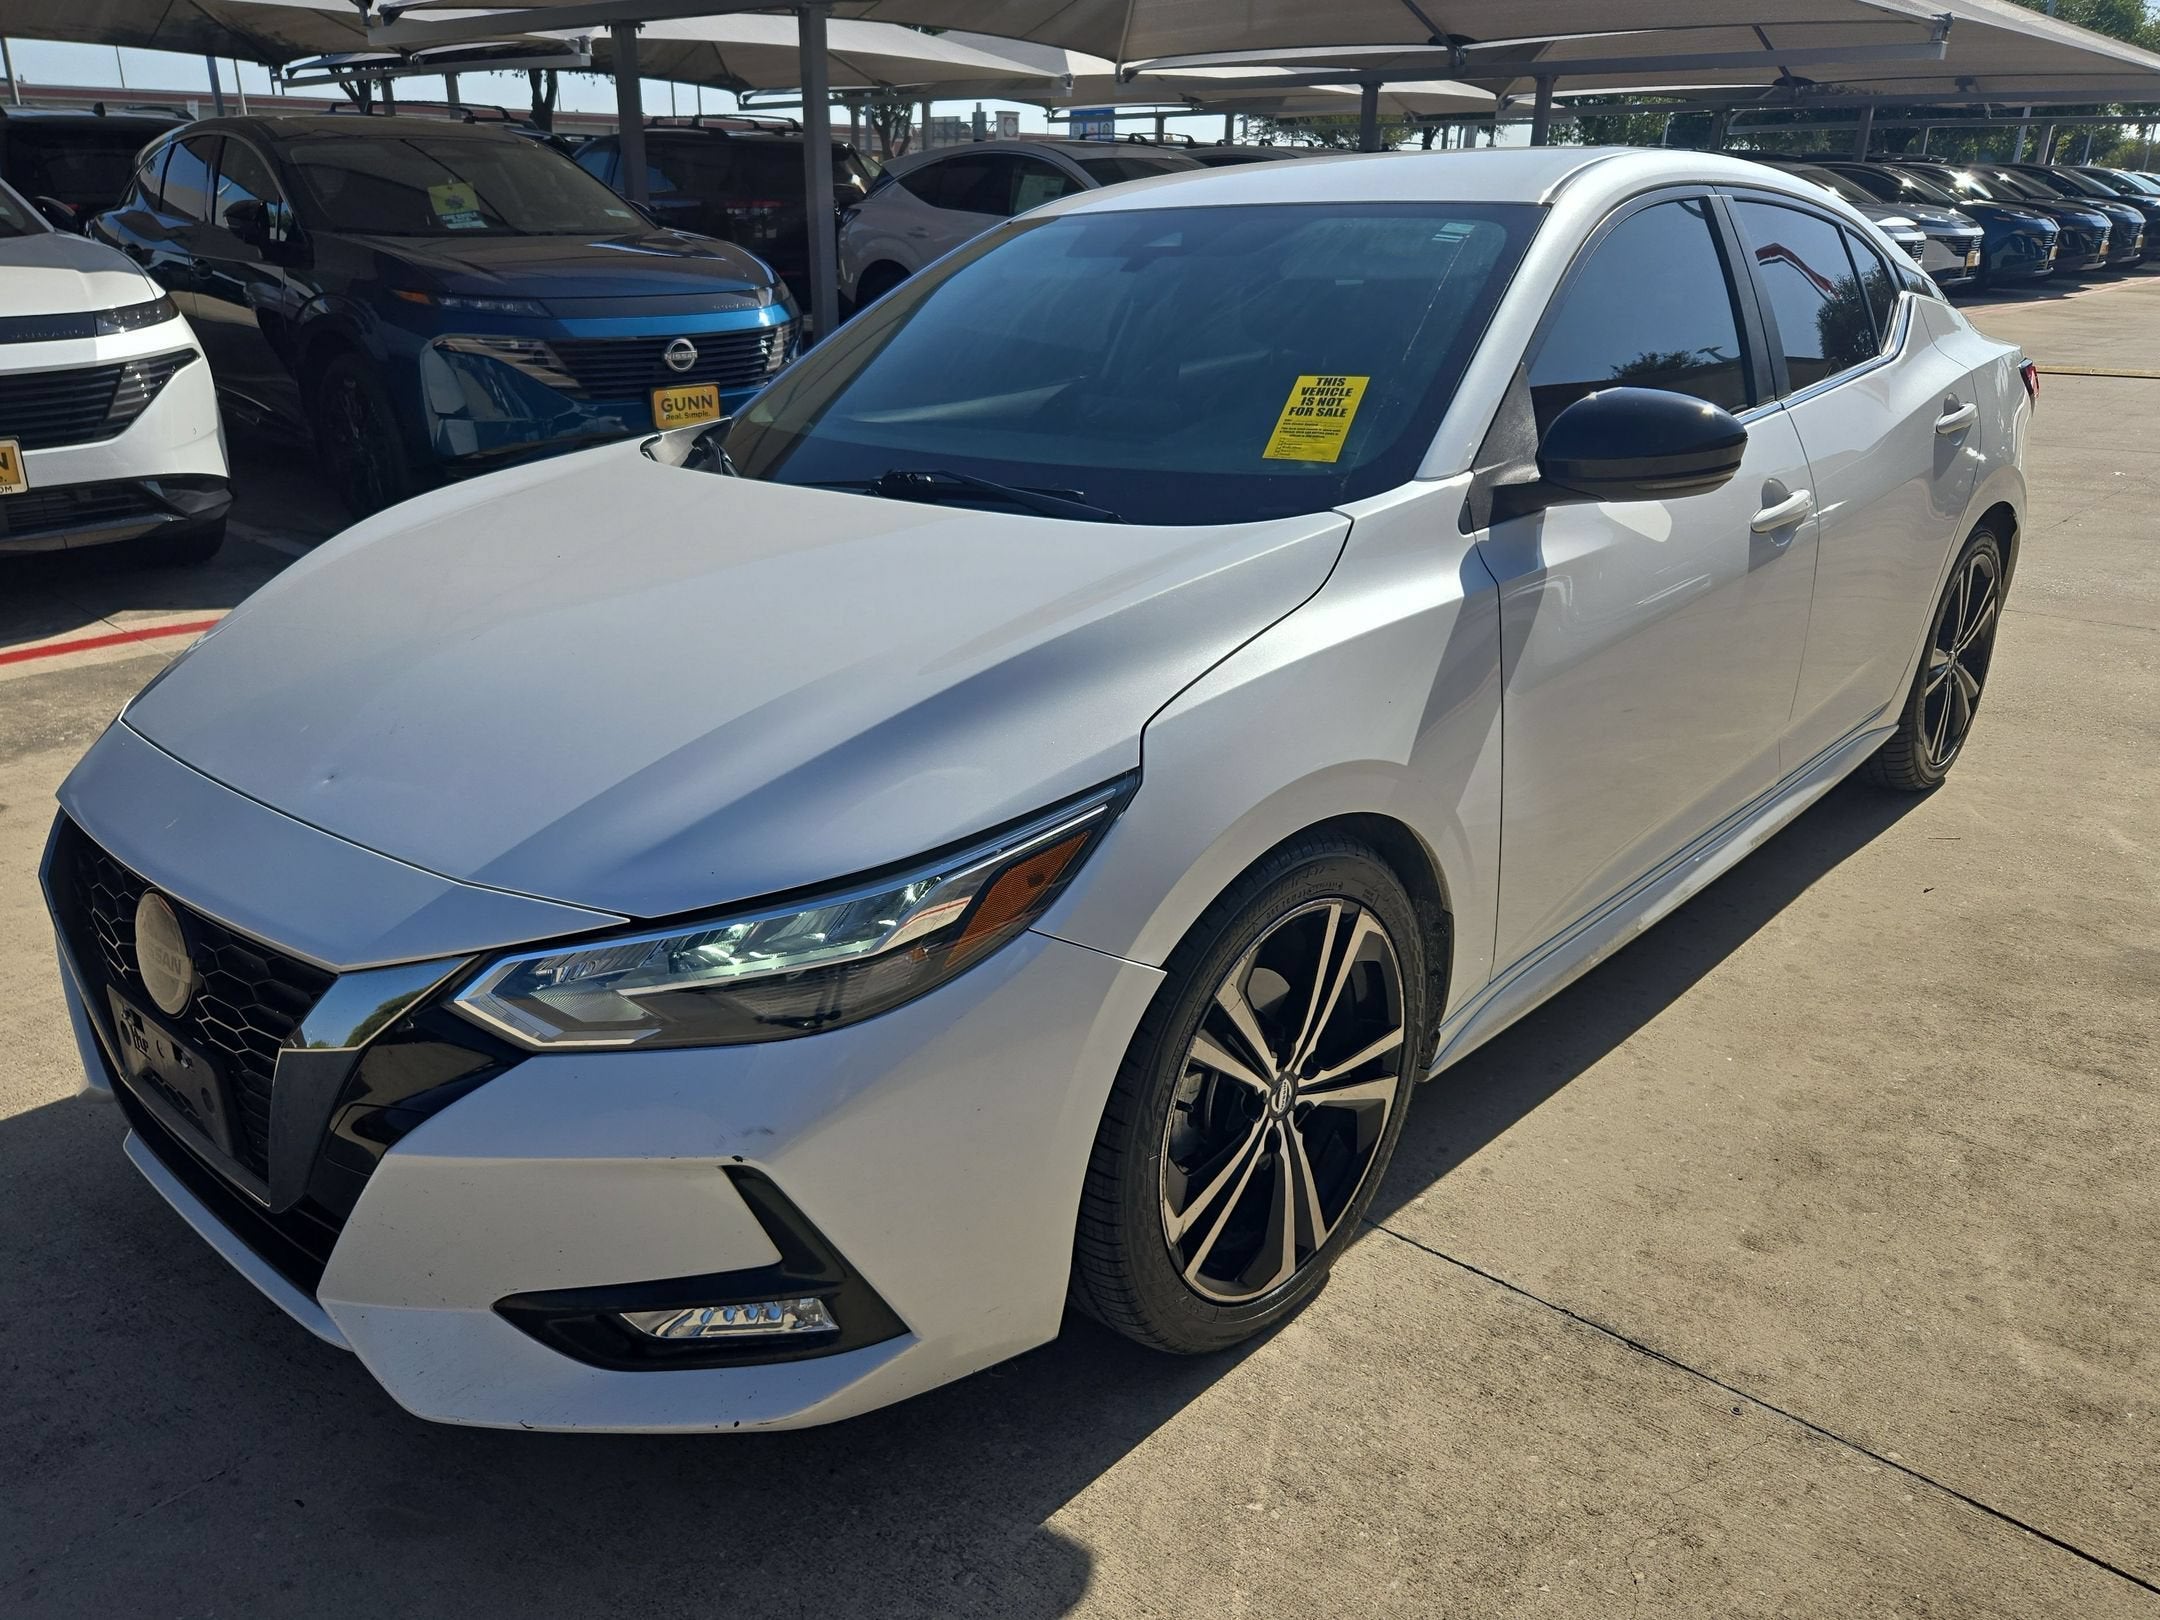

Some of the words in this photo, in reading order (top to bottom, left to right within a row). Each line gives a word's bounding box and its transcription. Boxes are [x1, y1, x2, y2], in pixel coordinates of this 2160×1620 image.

[664, 351, 698, 360] NISSAN
[1316, 377, 1346, 387] THIS
[1300, 387, 1354, 397] VEHICLE
[661, 394, 713, 413] GUNN
[1300, 397, 1314, 406] IS
[1316, 397, 1345, 407] NOT
[665, 413, 683, 421] Real.
[1288, 406, 1314, 417] FOR
[1316, 408, 1348, 418] SALE
